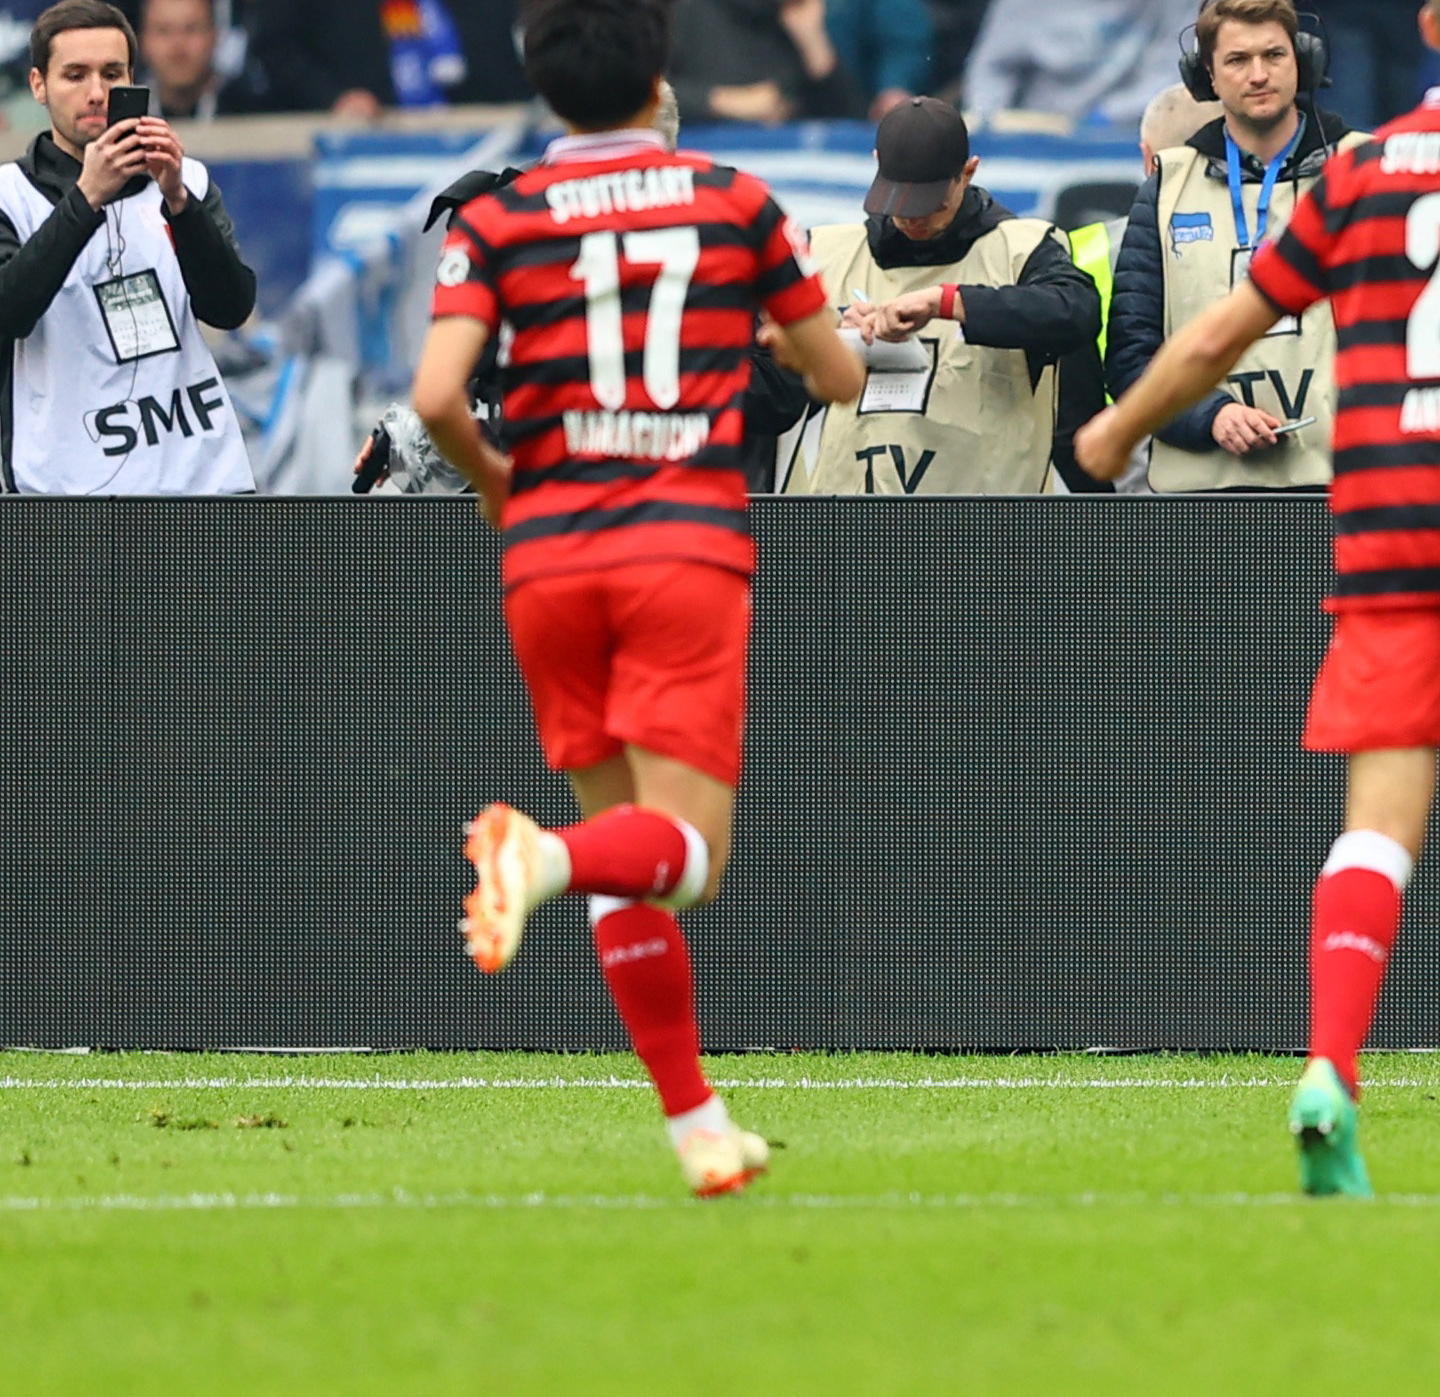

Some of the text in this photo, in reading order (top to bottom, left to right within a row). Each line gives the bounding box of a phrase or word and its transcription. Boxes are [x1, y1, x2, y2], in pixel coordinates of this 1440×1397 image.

[568, 225, 701, 411] 17
[94, 376, 225, 457] SMF
[1227, 368, 1315, 420] TV
[855, 444, 936, 494] TV
